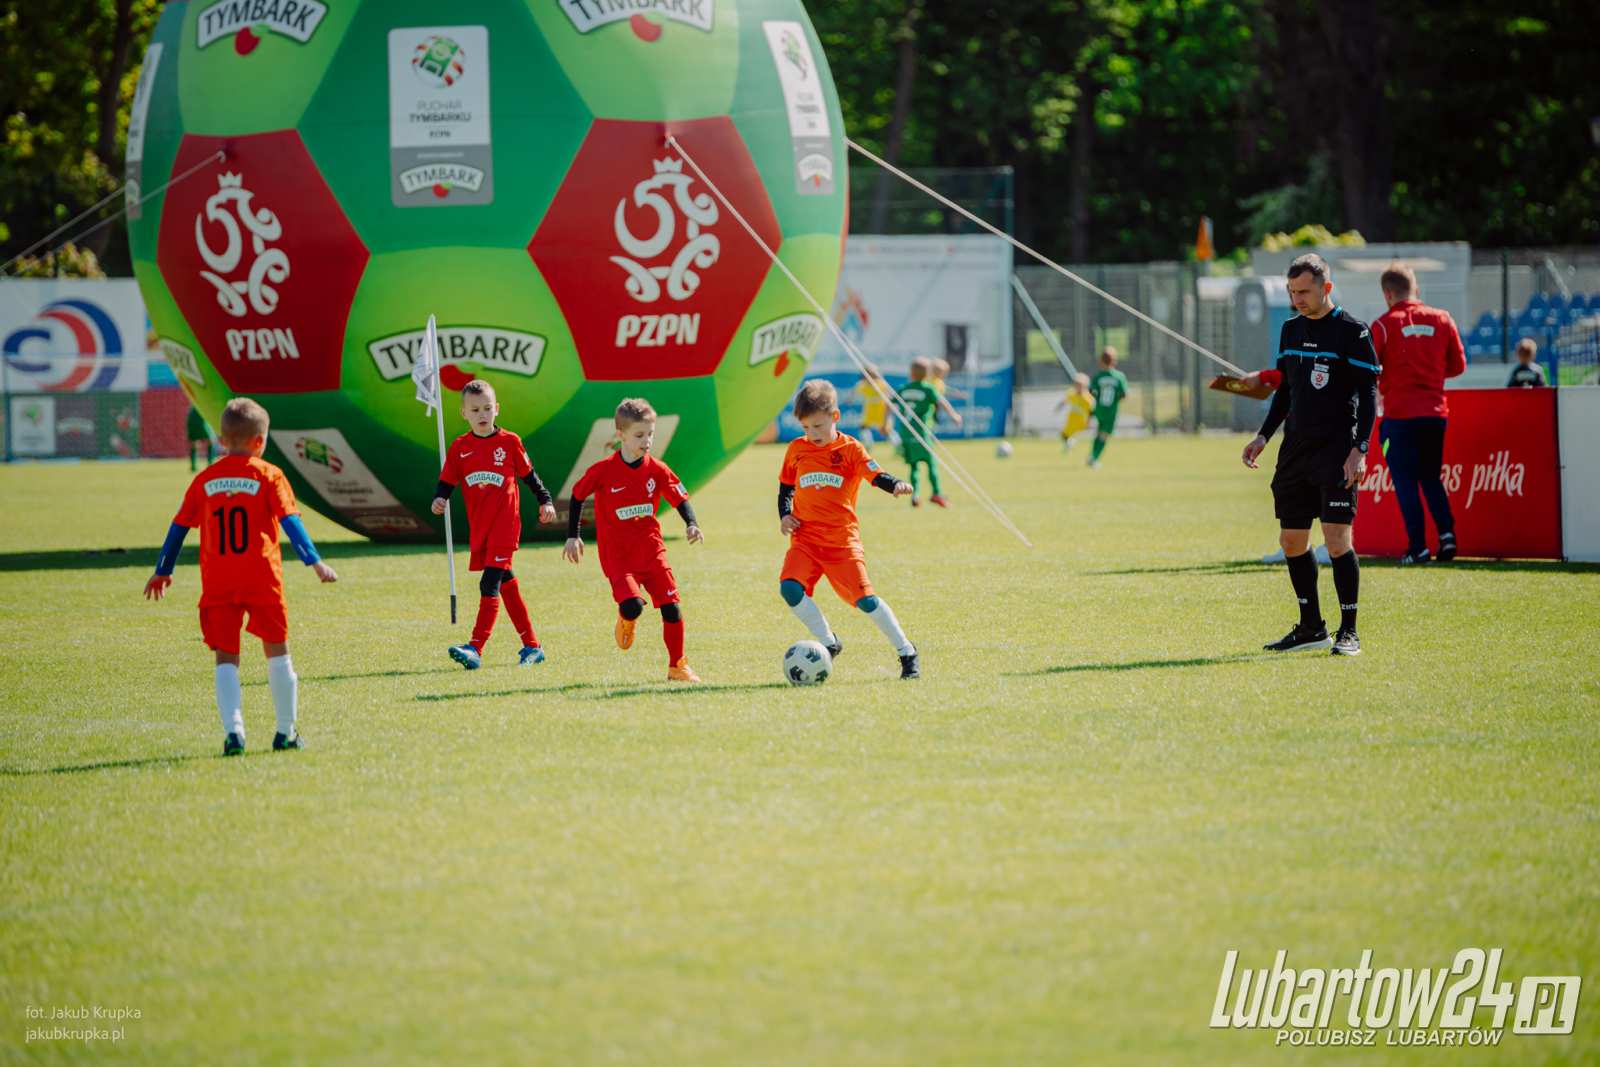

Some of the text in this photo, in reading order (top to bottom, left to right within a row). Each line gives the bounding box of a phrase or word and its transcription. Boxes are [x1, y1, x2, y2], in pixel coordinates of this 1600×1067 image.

[204, 0, 316, 35] TYMBARK
[225, 327, 300, 361] PZPN
[615, 312, 701, 348] PZPN
[1439, 462, 1464, 497] as
[1464, 450, 1526, 510] piłka
[618, 505, 653, 518] TYMBAR
[213, 505, 248, 555] 10
